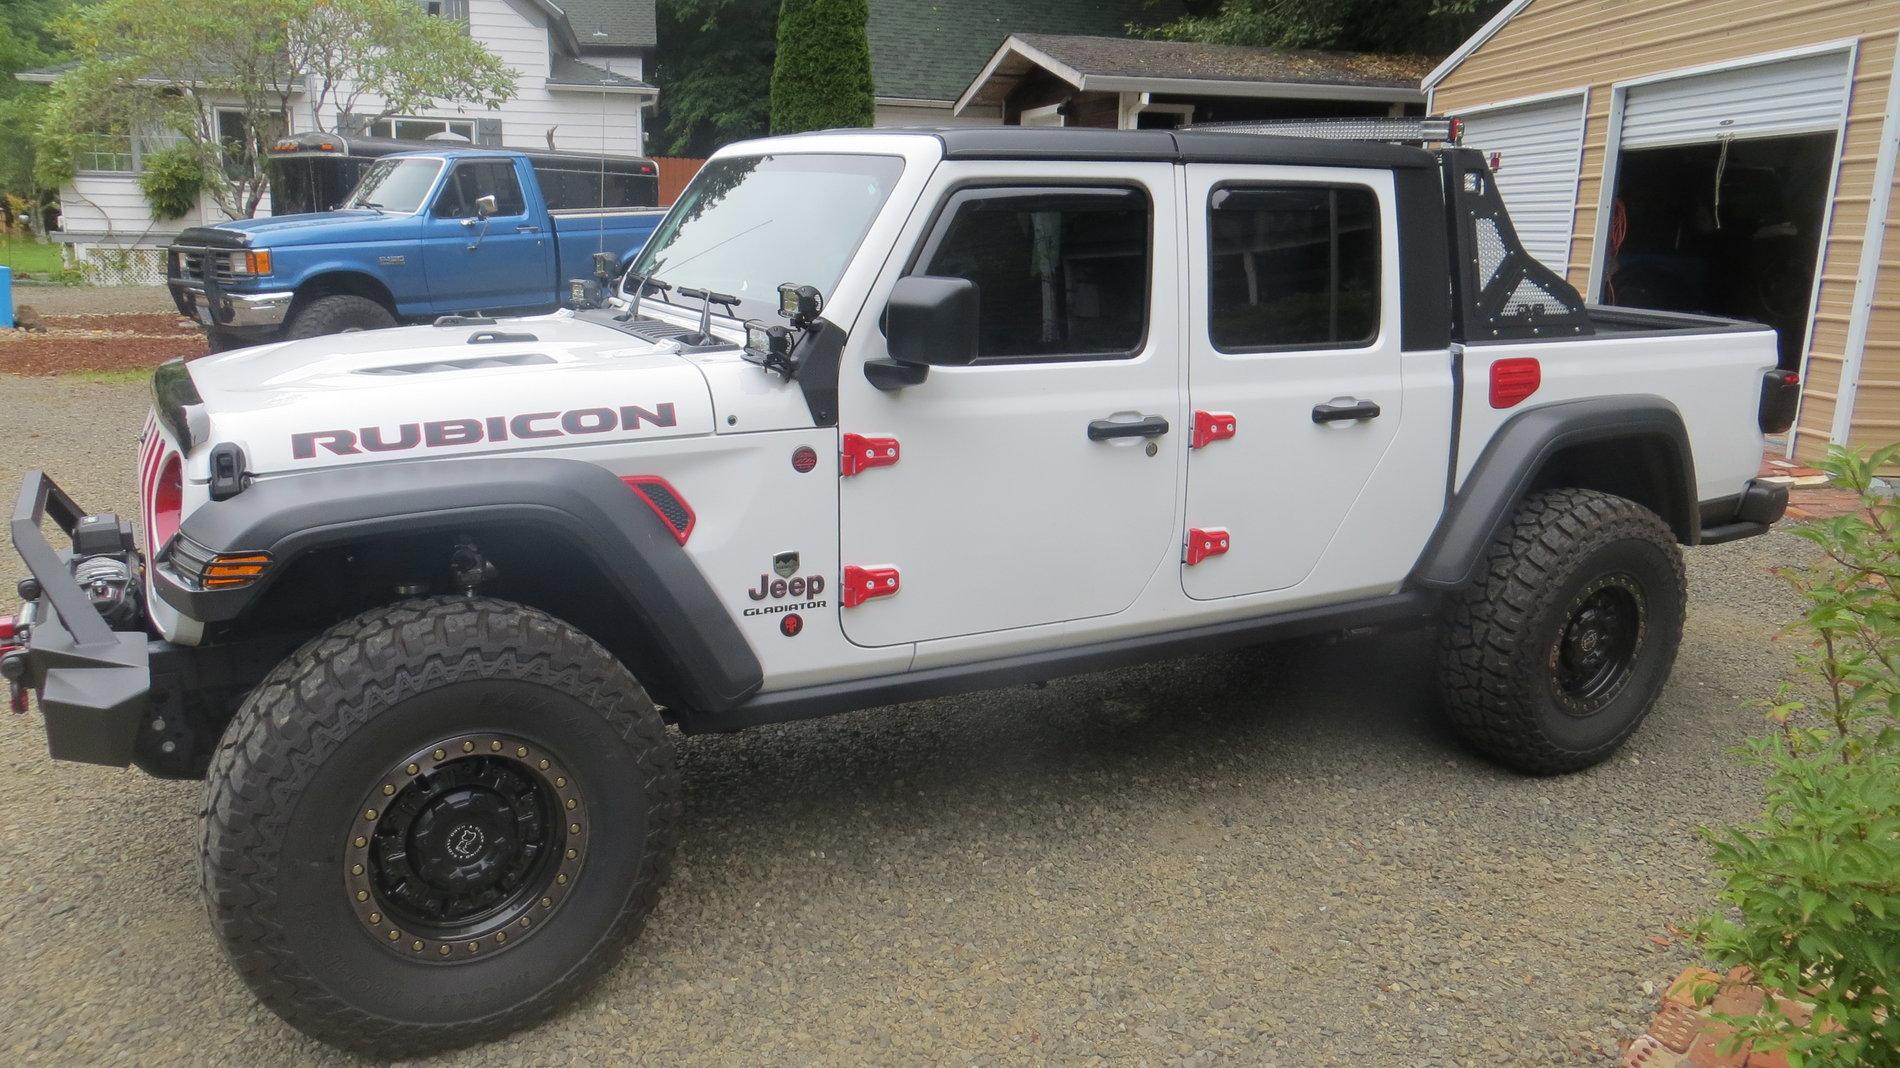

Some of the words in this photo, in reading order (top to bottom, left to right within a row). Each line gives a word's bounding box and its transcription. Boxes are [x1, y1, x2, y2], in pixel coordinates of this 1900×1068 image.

[291, 402, 677, 460] RUBICON
[748, 573, 825, 601] Jeep
[743, 600, 827, 616] GLADIATOR
